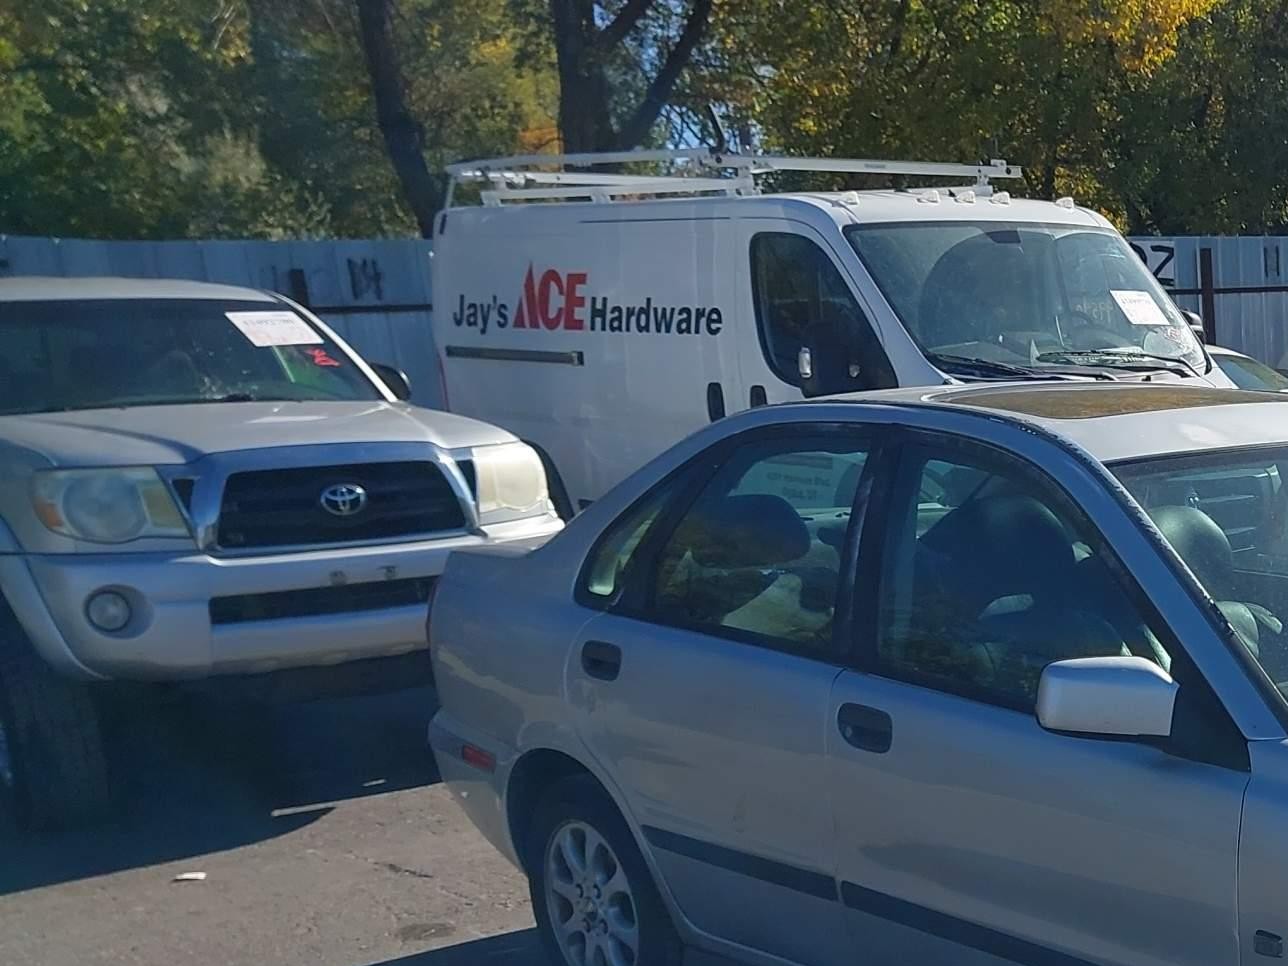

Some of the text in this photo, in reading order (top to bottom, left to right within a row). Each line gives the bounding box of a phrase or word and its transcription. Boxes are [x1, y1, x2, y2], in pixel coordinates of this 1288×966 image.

[452, 260, 723, 336] Jay's ACE Hardware
